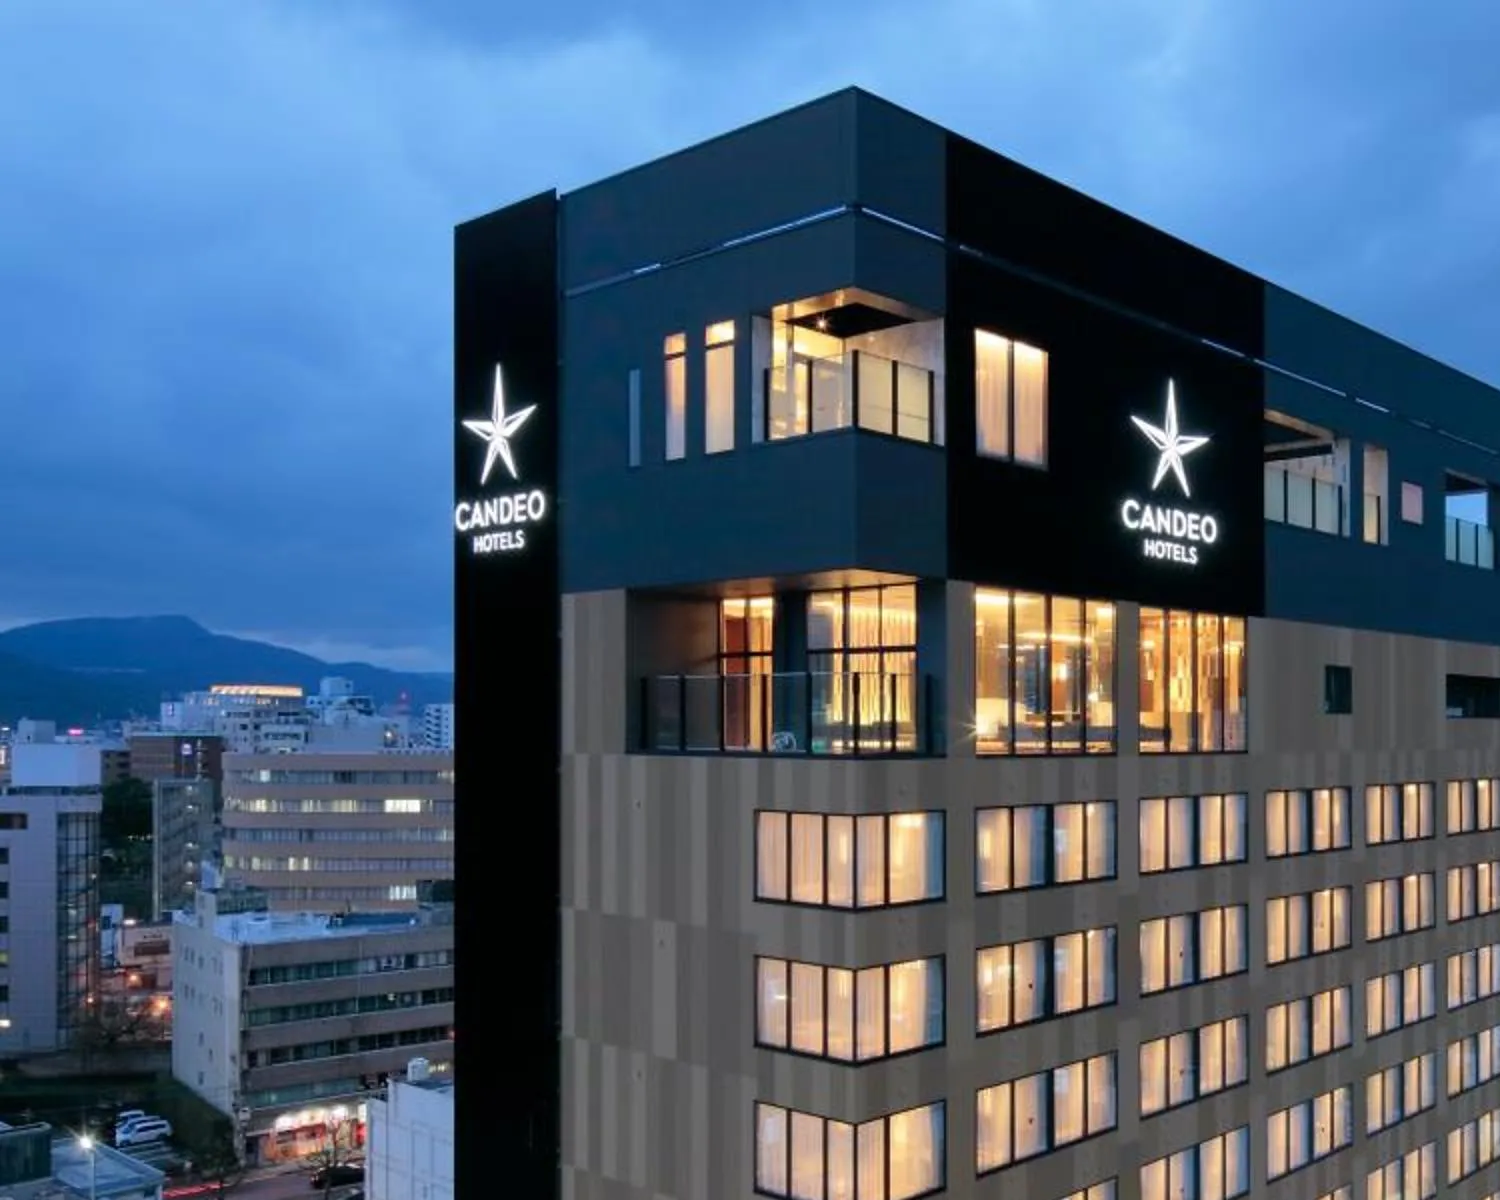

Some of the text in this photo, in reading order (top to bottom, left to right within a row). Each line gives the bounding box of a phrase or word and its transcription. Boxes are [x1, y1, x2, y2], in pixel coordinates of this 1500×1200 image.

[455, 490, 546, 531] CANDEO
[1121, 499, 1218, 544] CANDEO
[473, 530, 525, 554] HOTELS
[1144, 539, 1198, 565] HOTELS
